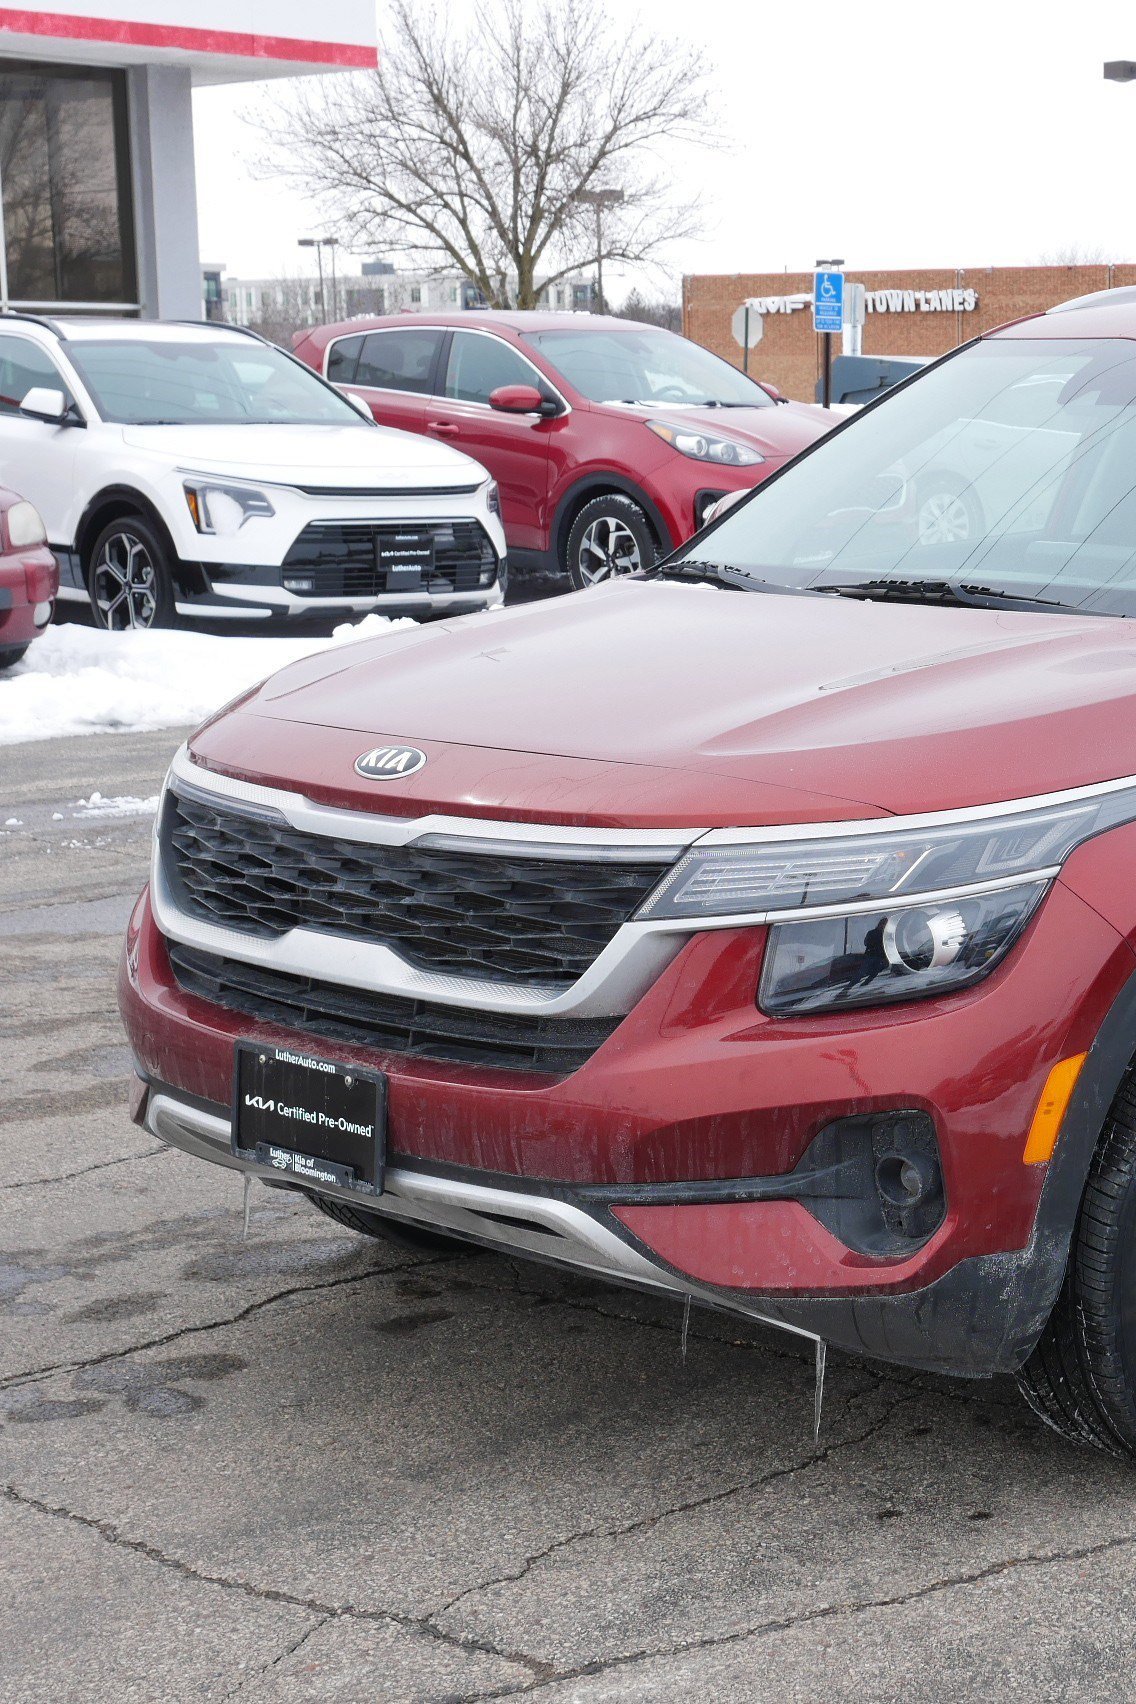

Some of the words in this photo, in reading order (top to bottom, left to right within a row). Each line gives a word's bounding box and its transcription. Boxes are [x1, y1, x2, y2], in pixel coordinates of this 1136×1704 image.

[919, 288, 976, 311] LANES
[360, 748, 413, 772] KIA
[275, 1048, 336, 1074] LutherAuto.com
[277, 1102, 317, 1124] Certified
[318, 1112, 372, 1138] Pre-Owned
[295, 1154, 306, 1165] Kia
[306, 1158, 314, 1168] of
[295, 1163, 336, 1183] Bloomington
